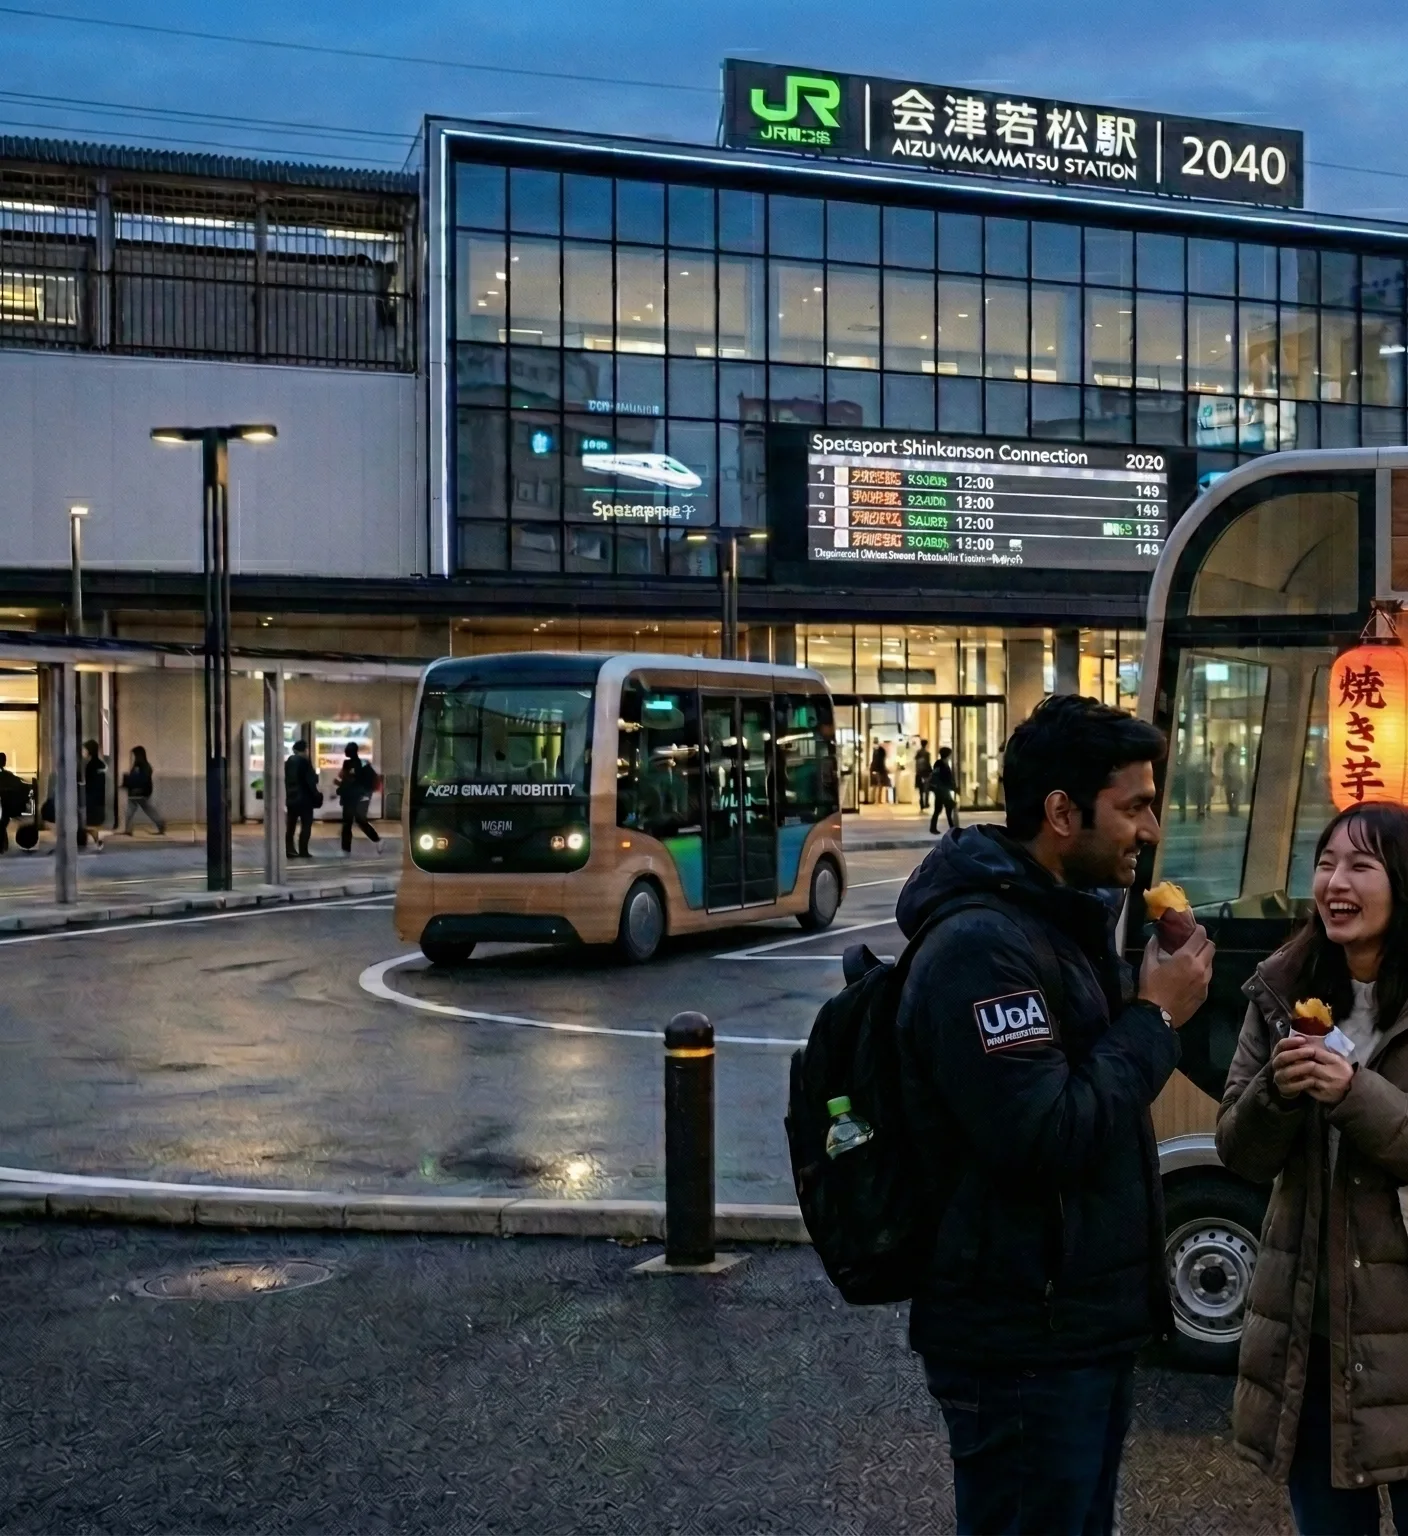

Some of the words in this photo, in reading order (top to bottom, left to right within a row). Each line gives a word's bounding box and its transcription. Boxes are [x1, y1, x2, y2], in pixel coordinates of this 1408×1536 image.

[751, 75, 841, 128] JR
[891, 88, 1138, 160] 会津若松駅
[1181, 136, 1286, 185] 2040
[892, 138, 935, 158] AIZU
[937, 142, 1059, 173] WAKAMATSU
[1065, 157, 1137, 181] STATION
[999, 445, 1088, 465] Connection
[817, 468, 825, 481] 1
[956, 475, 994, 490] 12:00
[956, 515, 994, 530] 12:00
[1338, 664, 1388, 802] 焼き芋
